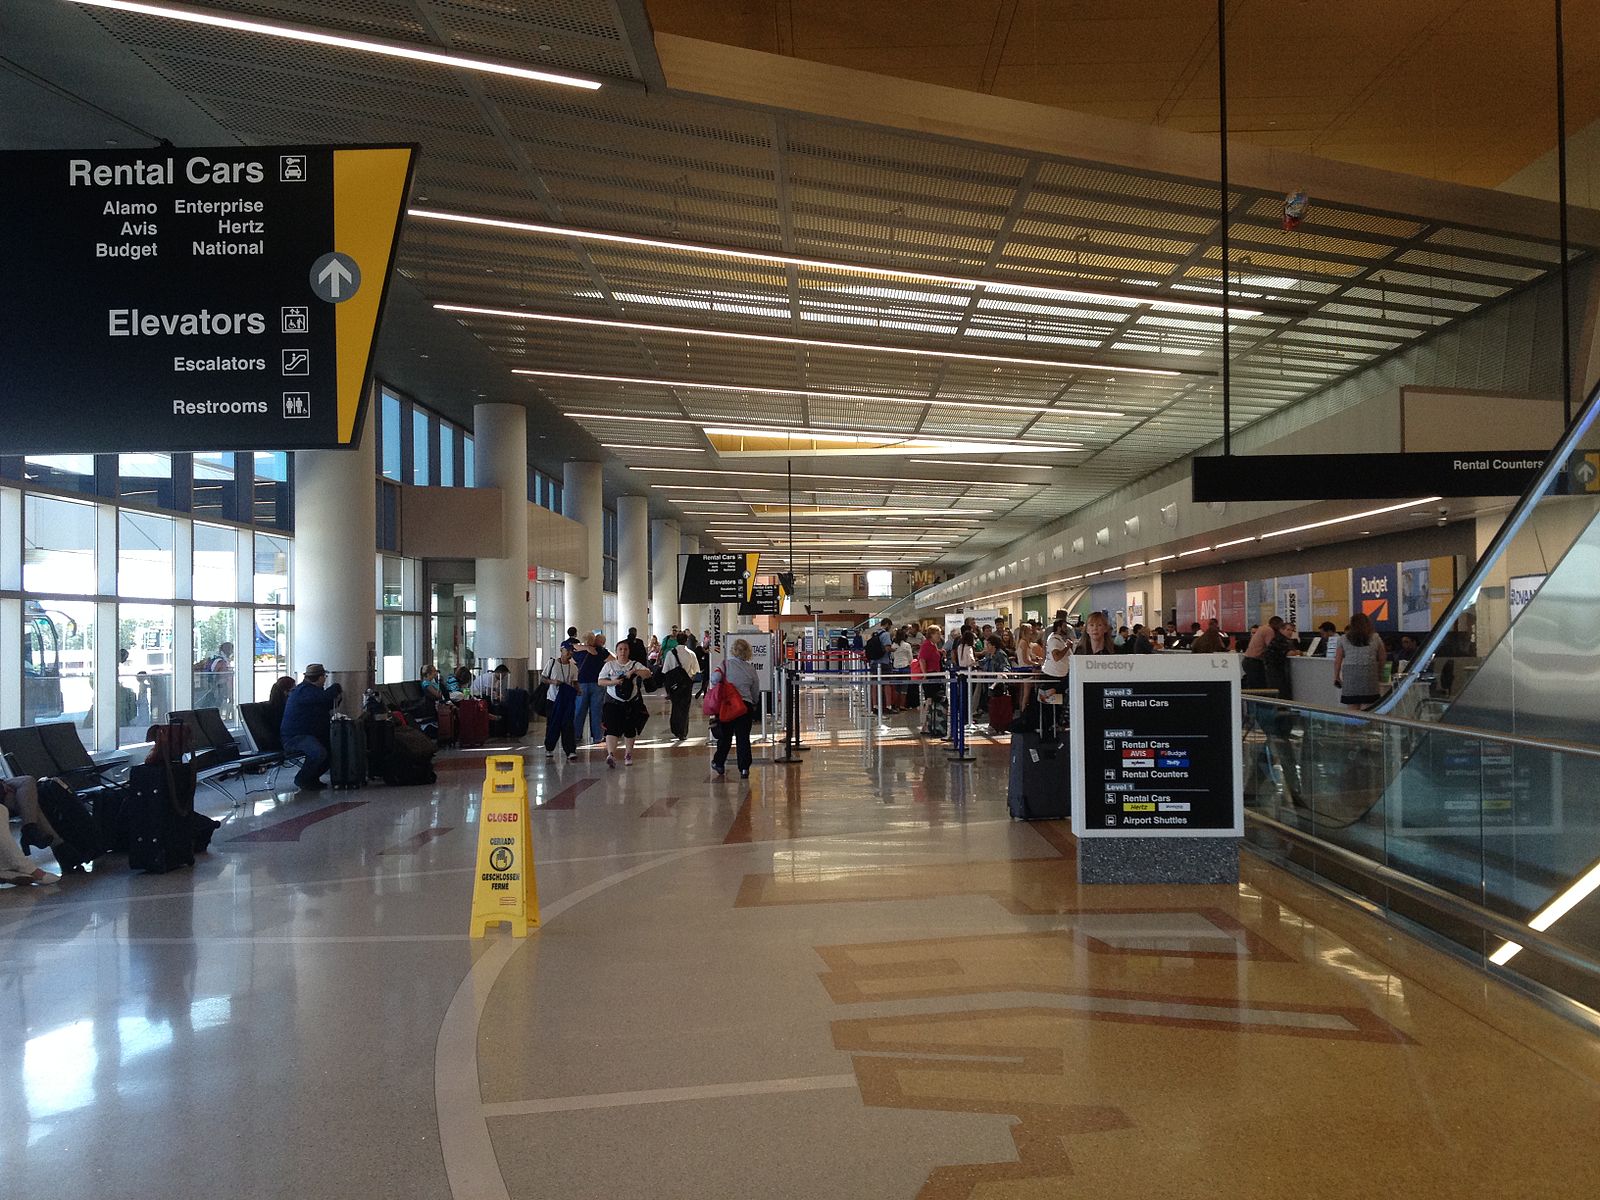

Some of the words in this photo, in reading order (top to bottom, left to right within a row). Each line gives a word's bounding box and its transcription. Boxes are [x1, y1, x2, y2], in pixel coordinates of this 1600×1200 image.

[69, 157, 174, 186] Rental
[185, 156, 264, 185] Cars
[102, 200, 158, 215] Alamo
[174, 199, 264, 217] Enterprise
[120, 221, 158, 236] Avis
[218, 219, 265, 234] Hertz
[96, 242, 158, 261] Budget
[192, 239, 264, 256] National
[108, 308, 266, 337] Elevators
[174, 356, 266, 372] Escalators
[173, 399, 268, 415] Restrooms
[1453, 459, 1490, 470] Rental
[1492, 459, 1544, 470] Counters
[1360, 575, 1389, 599] Budget
[1200, 599, 1217, 620] AVIS
[1085, 660, 1135, 672] Directory
[1211, 659, 1219, 669] L
[1221, 659, 1229, 669] 2
[1121, 699, 1148, 707] Rental
[1149, 699, 1169, 707] Cars
[1121, 740, 1148, 749] Rental
[1149, 740, 1170, 749] Cars
[1122, 770, 1149, 779] Rental
[1150, 770, 1189, 779] Counters
[1106, 783, 1127, 791] Level
[1122, 794, 1150, 802] Rental
[1151, 794, 1171, 802] Cars
[486, 812, 519, 823] CLOSED
[1122, 816, 1152, 826] Airport
[1153, 816, 1188, 825] Shuttles
[481, 873, 520, 882] GESCHLOSSEN
